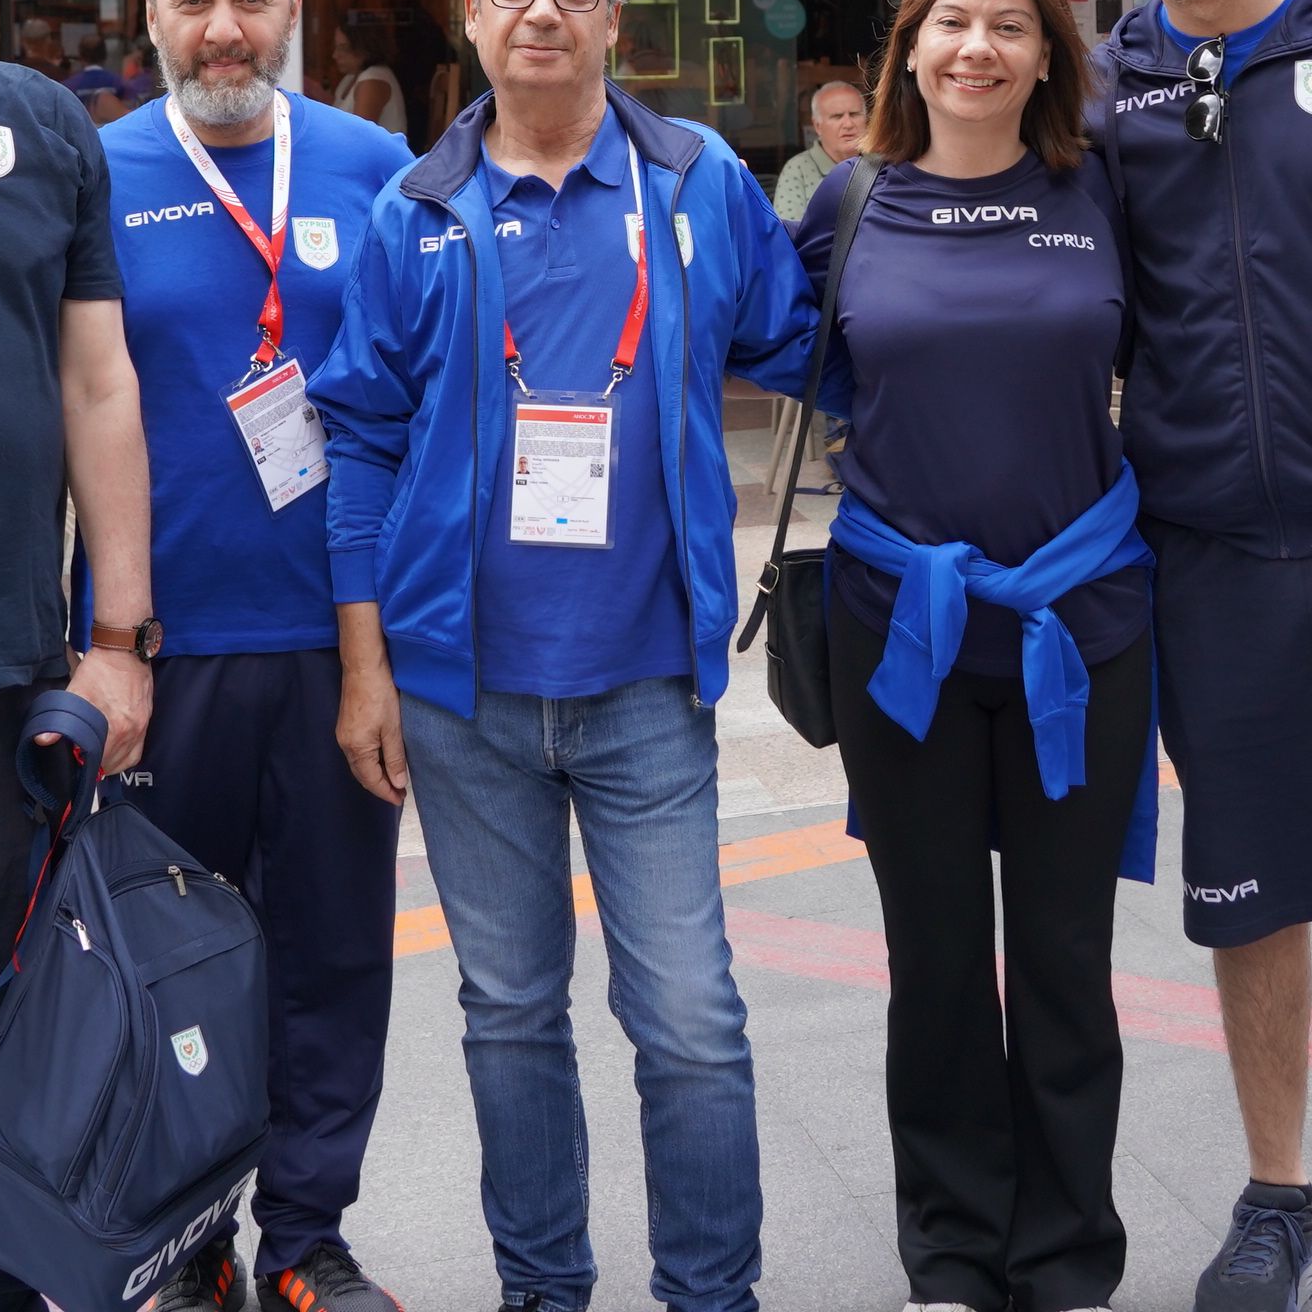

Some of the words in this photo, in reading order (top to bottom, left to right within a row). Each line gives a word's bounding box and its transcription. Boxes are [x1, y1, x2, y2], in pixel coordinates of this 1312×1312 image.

[125, 201, 214, 227] GIVOVA
[298, 220, 332, 228] CYPRUS
[931, 205, 1038, 224] GIVOVA
[1028, 234, 1095, 251] CYPRUS
[1183, 879, 1259, 903] IVOVA
[122, 1168, 255, 1301] GIVOVA
